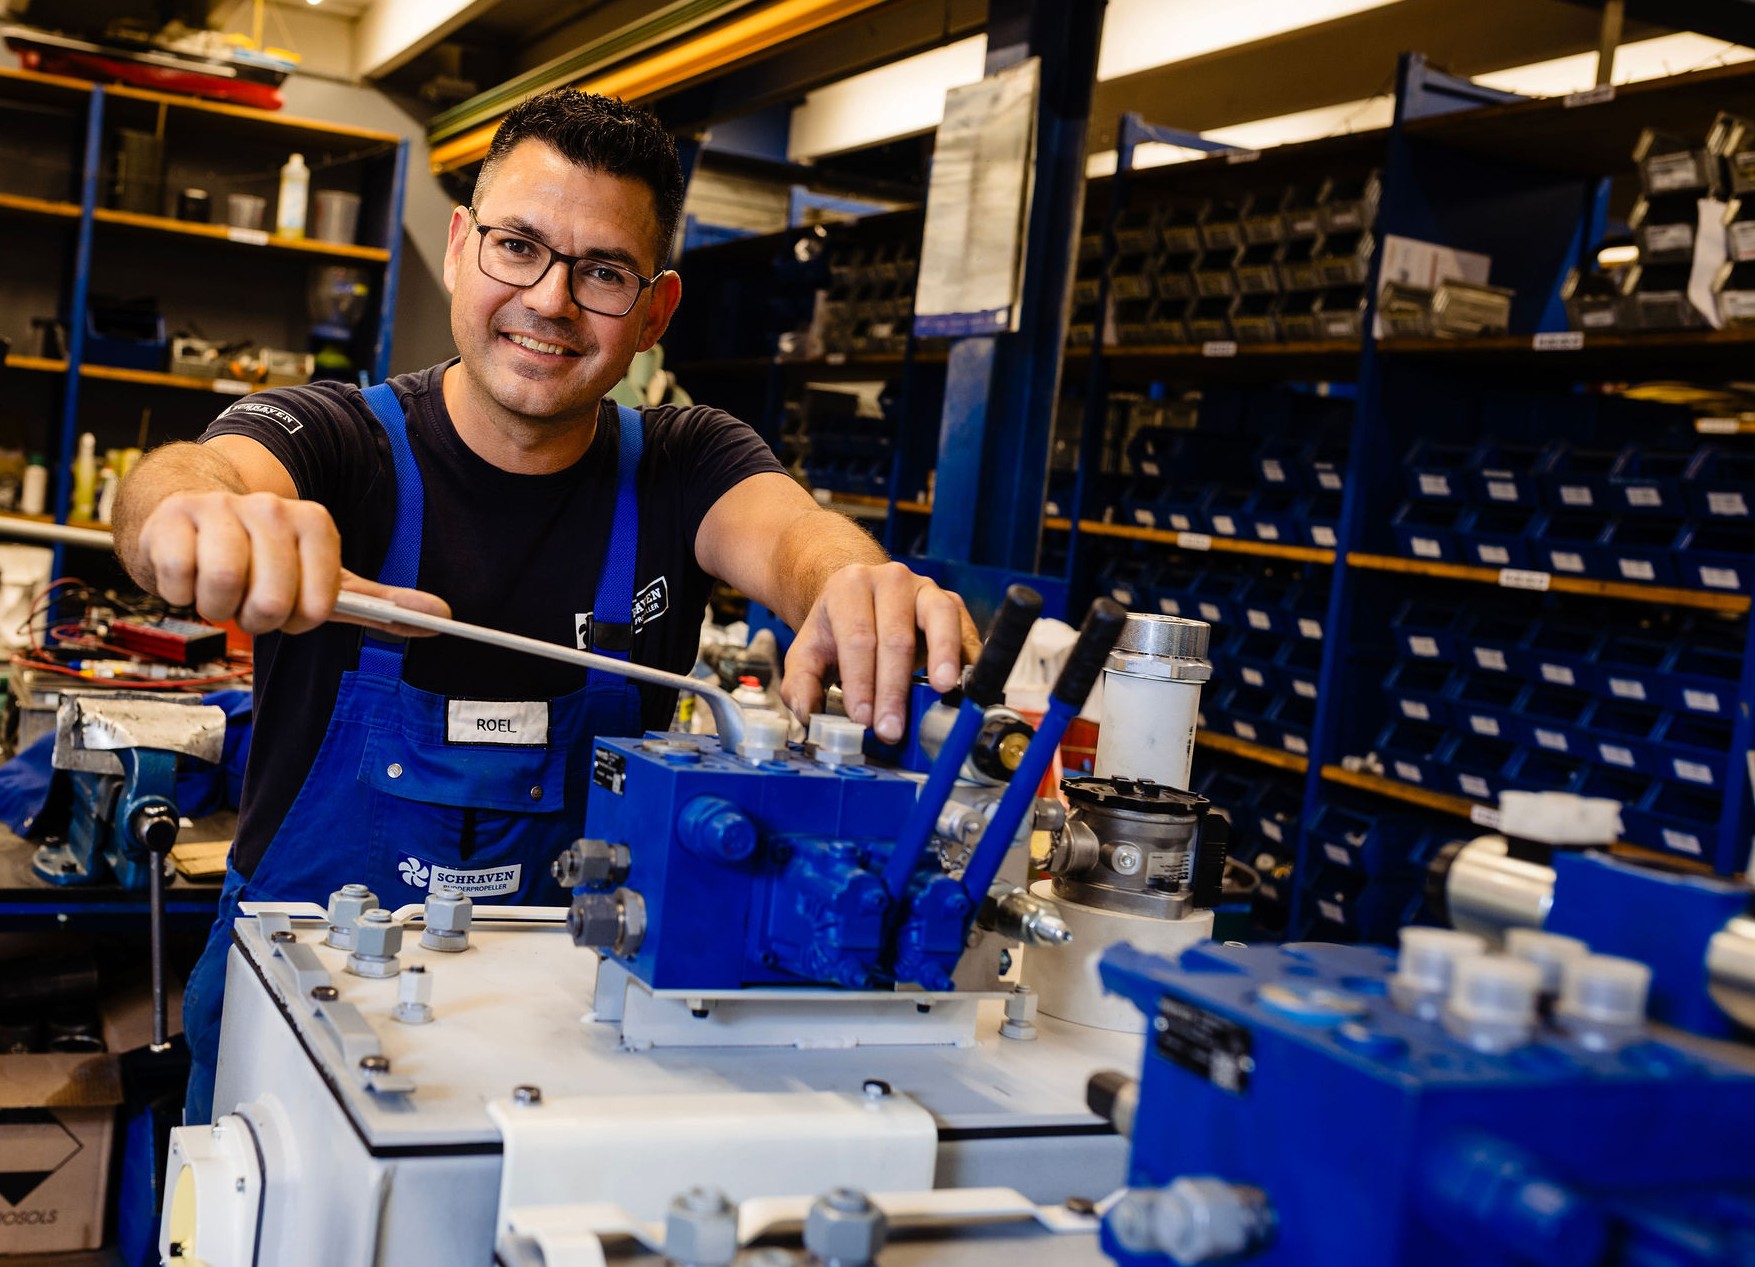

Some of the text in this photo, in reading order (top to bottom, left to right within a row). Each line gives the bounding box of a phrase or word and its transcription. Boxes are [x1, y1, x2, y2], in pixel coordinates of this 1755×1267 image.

[476, 718, 517, 734] ROEL
[437, 870, 515, 885] SCHRAVEN
[0, 1209, 58, 1227] OSOLS
